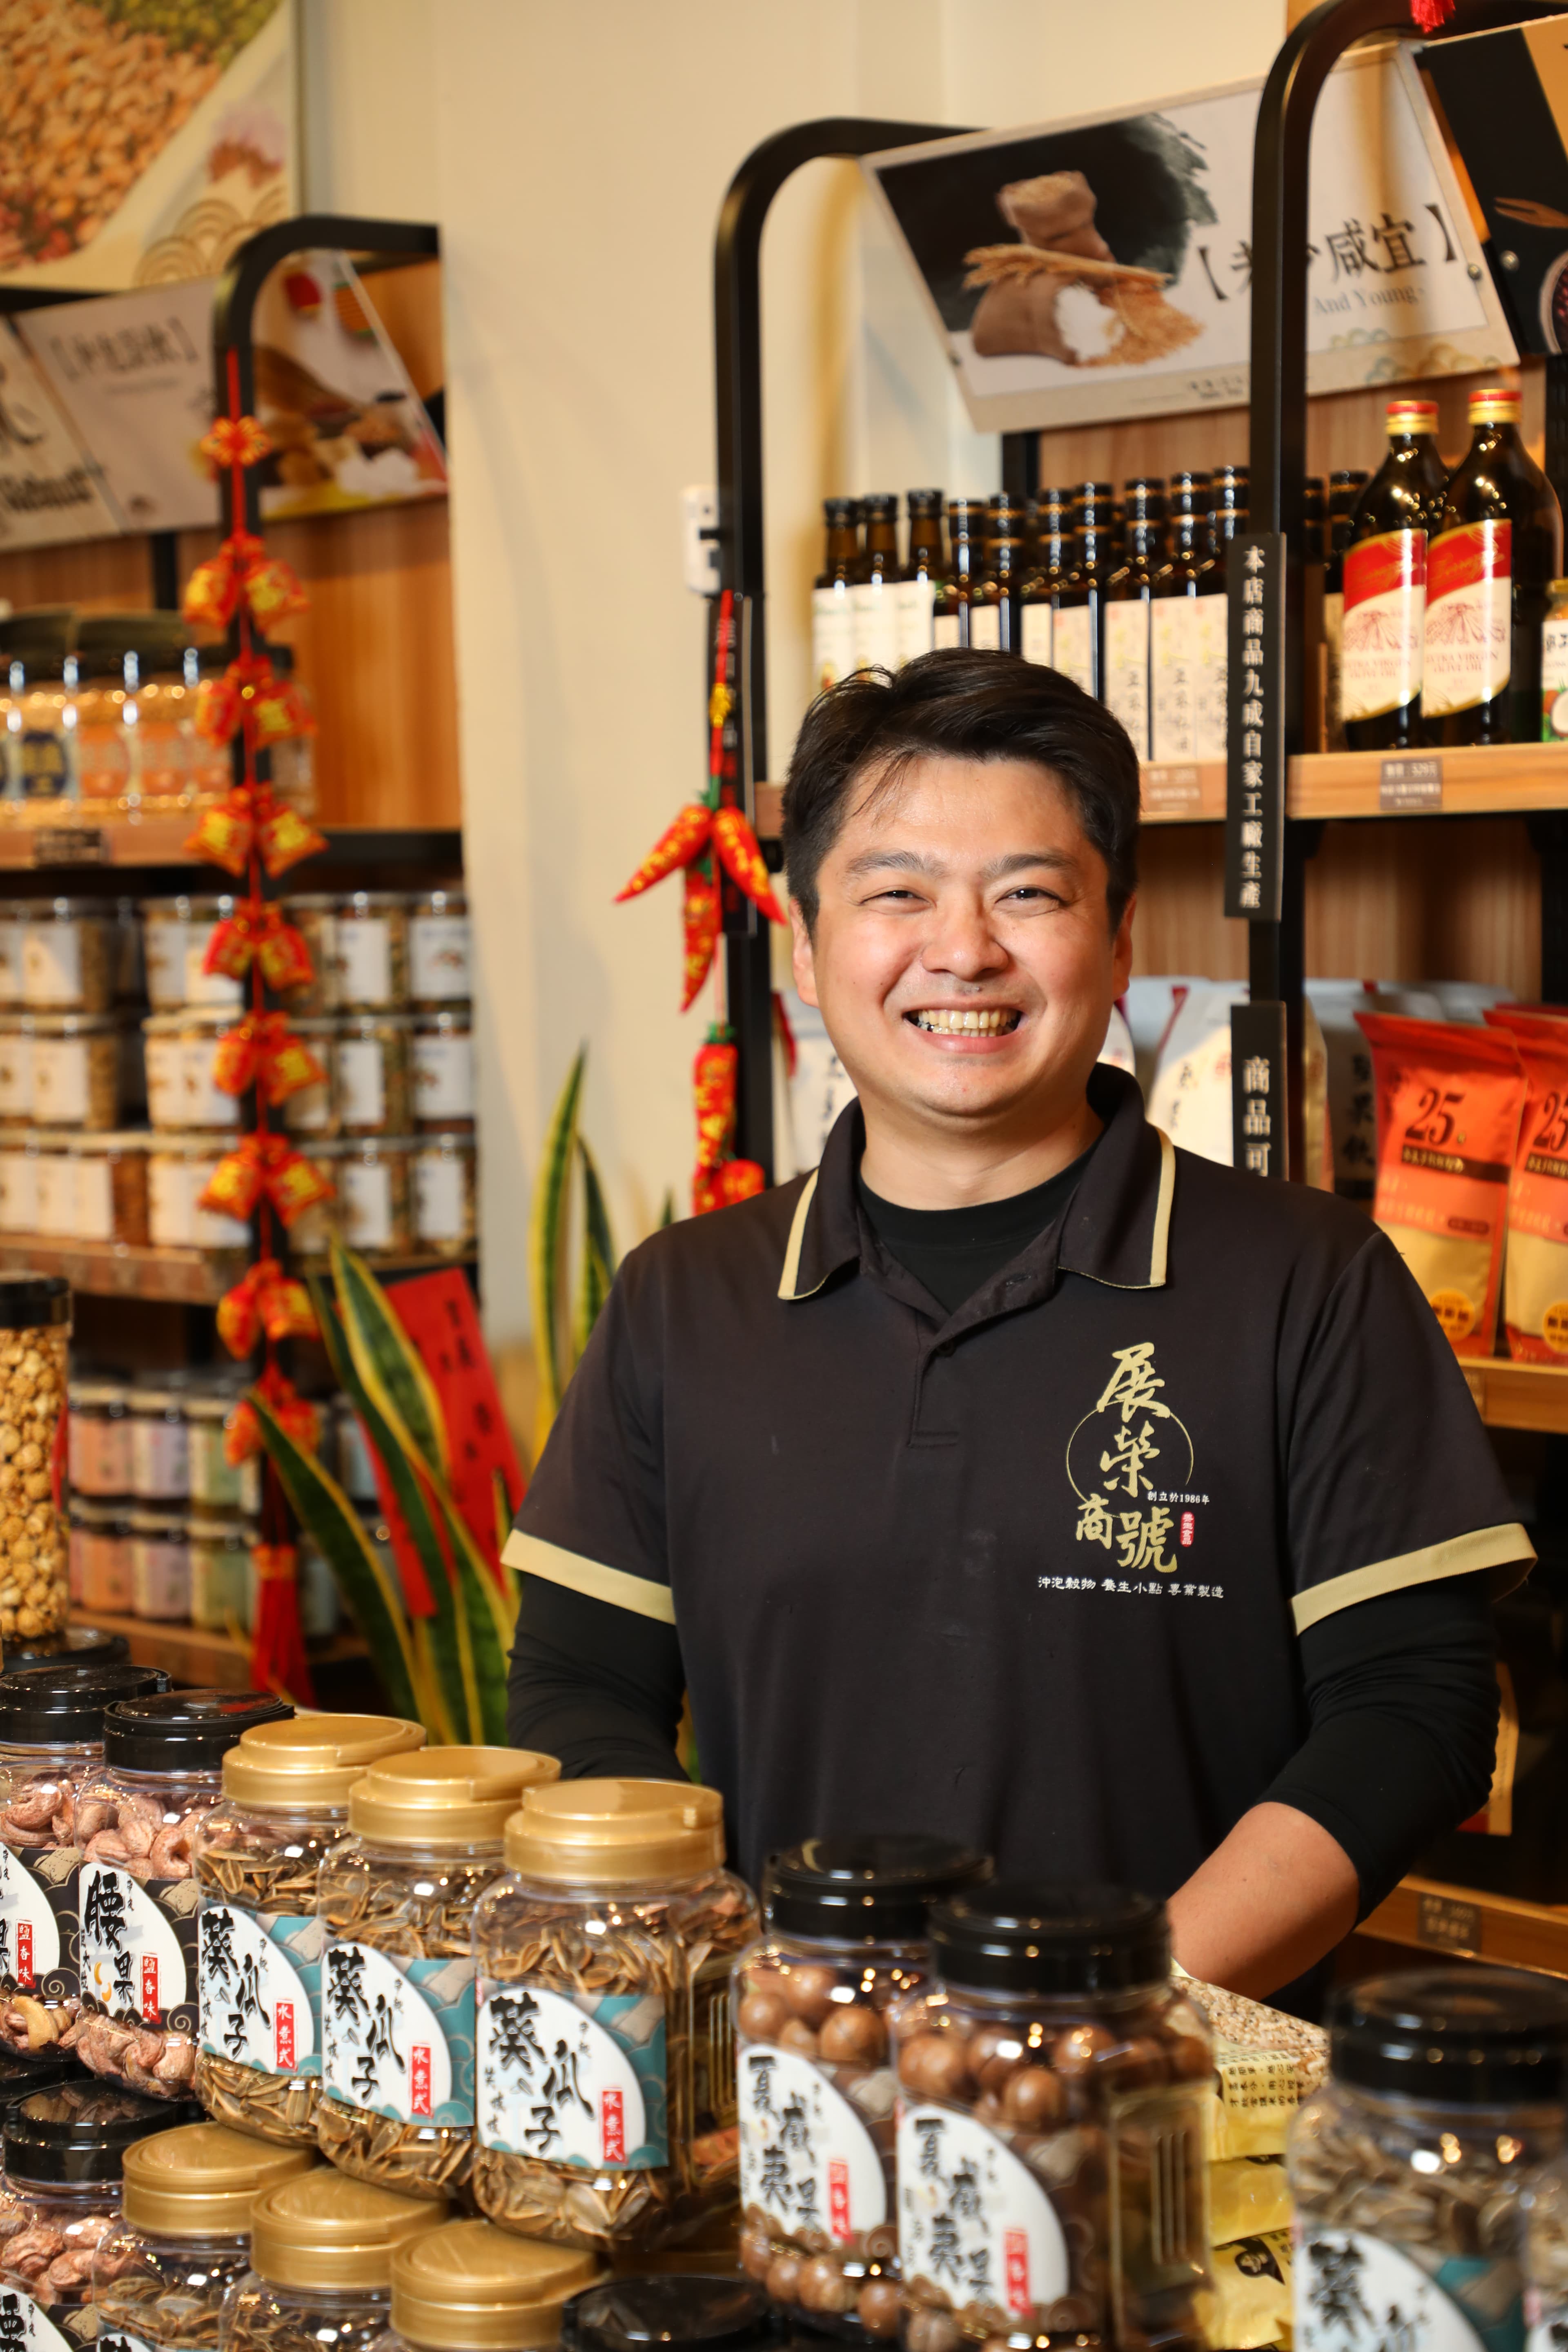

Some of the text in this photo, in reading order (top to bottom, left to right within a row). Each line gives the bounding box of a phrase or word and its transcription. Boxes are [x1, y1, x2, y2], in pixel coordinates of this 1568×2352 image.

[1314, 293, 1350, 315] And
[1405, 1088, 1465, 1146] 25
[1076, 1342, 1178, 1573] 展榮商號
[1148, 1491, 1209, 1505] 創立於1986年
[19, 1925, 31, 1982] 鹽香味
[84, 1869, 134, 2006] 腰果
[143, 1958, 156, 2018] 鹽香味
[202, 1908, 271, 2059] 葵瓜子
[277, 2005, 293, 2068] 水煮式
[327, 1946, 405, 2103] 葵瓜子
[413, 2048, 429, 2114] 水煮式
[490, 1991, 595, 2156] 葵瓜子
[604, 2093, 623, 2161] 水煮式
